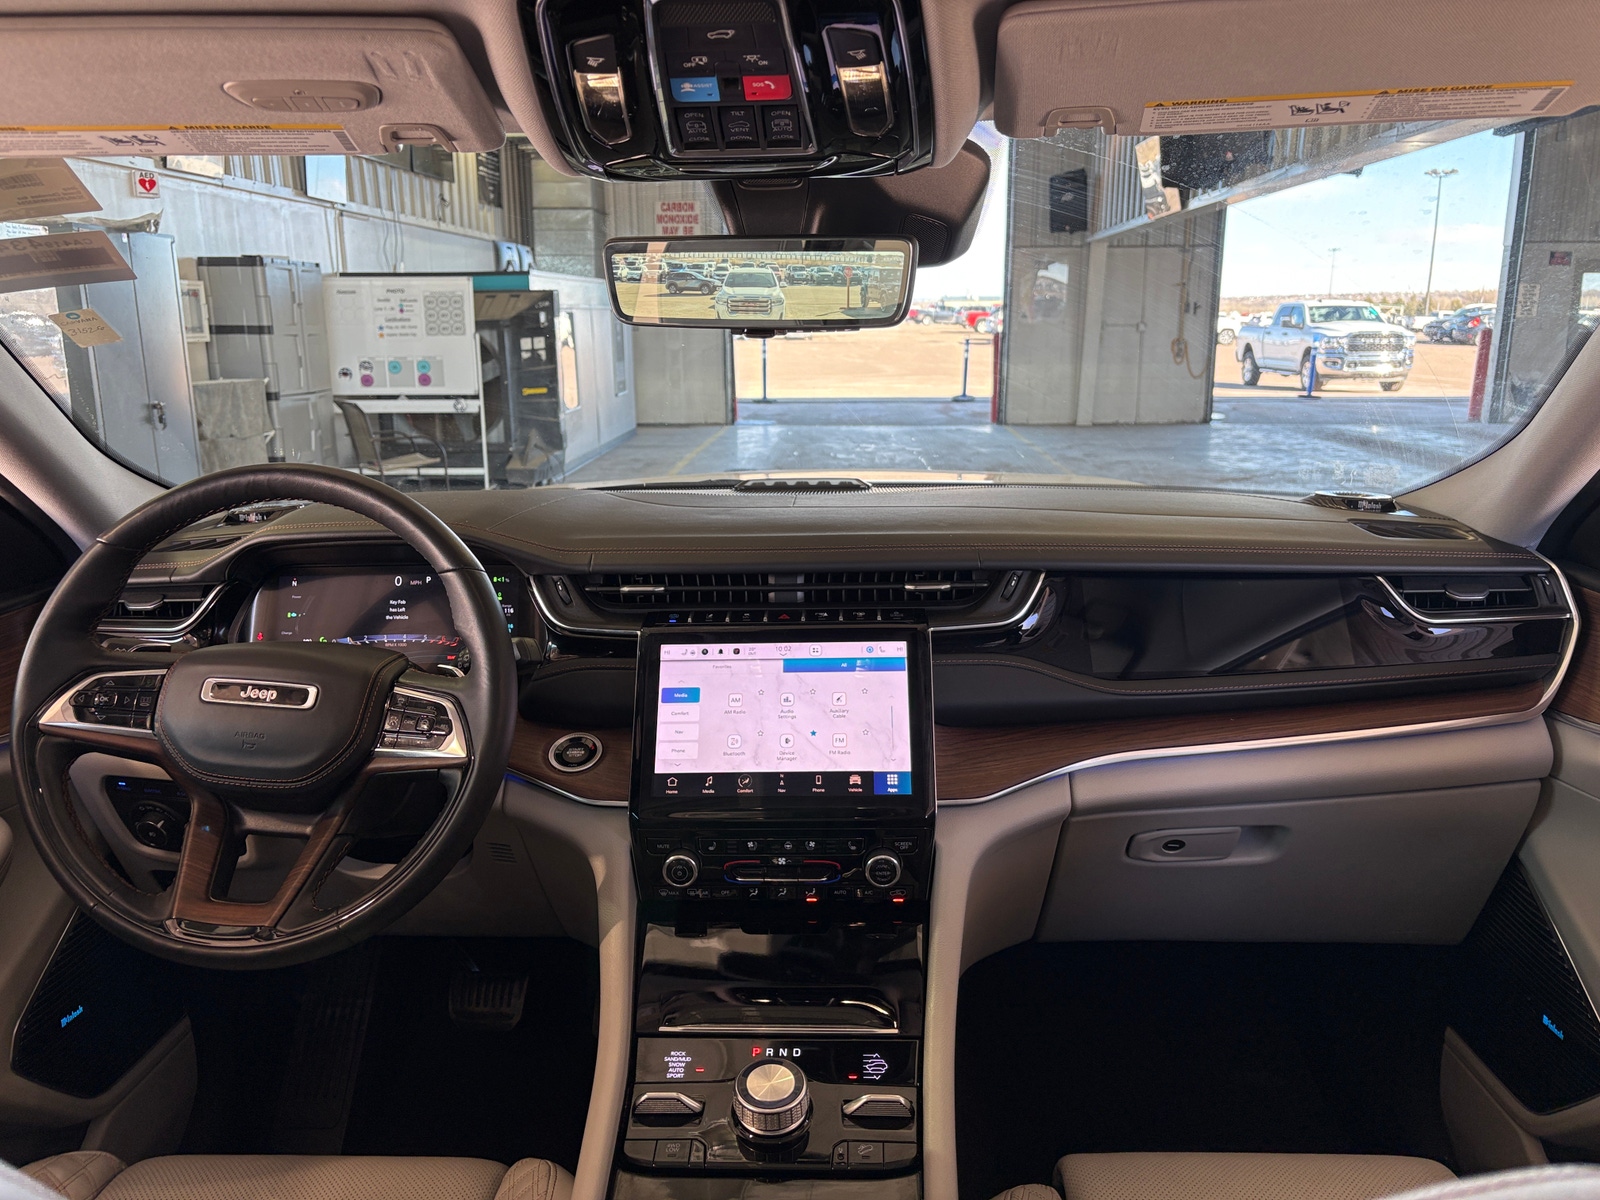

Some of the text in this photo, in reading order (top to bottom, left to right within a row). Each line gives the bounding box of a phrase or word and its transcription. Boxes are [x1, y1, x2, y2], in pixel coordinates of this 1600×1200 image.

[1171, 98, 1228, 107] WARNING
[139, 171, 154, 179] AED
[660, 202, 694, 212] CARBON
[656, 214, 699, 225] MONOXIDE
[662, 226, 679, 236] MAY
[394, 575, 403, 587] 0
[425, 576, 432, 584] P
[240, 685, 278, 702] Jeep
[829, 707, 850, 715] Auxiliary
[234, 731, 266, 740] AIRBAG
[834, 736, 845, 744] FM
[751, 1047, 801, 1057] P R N D
